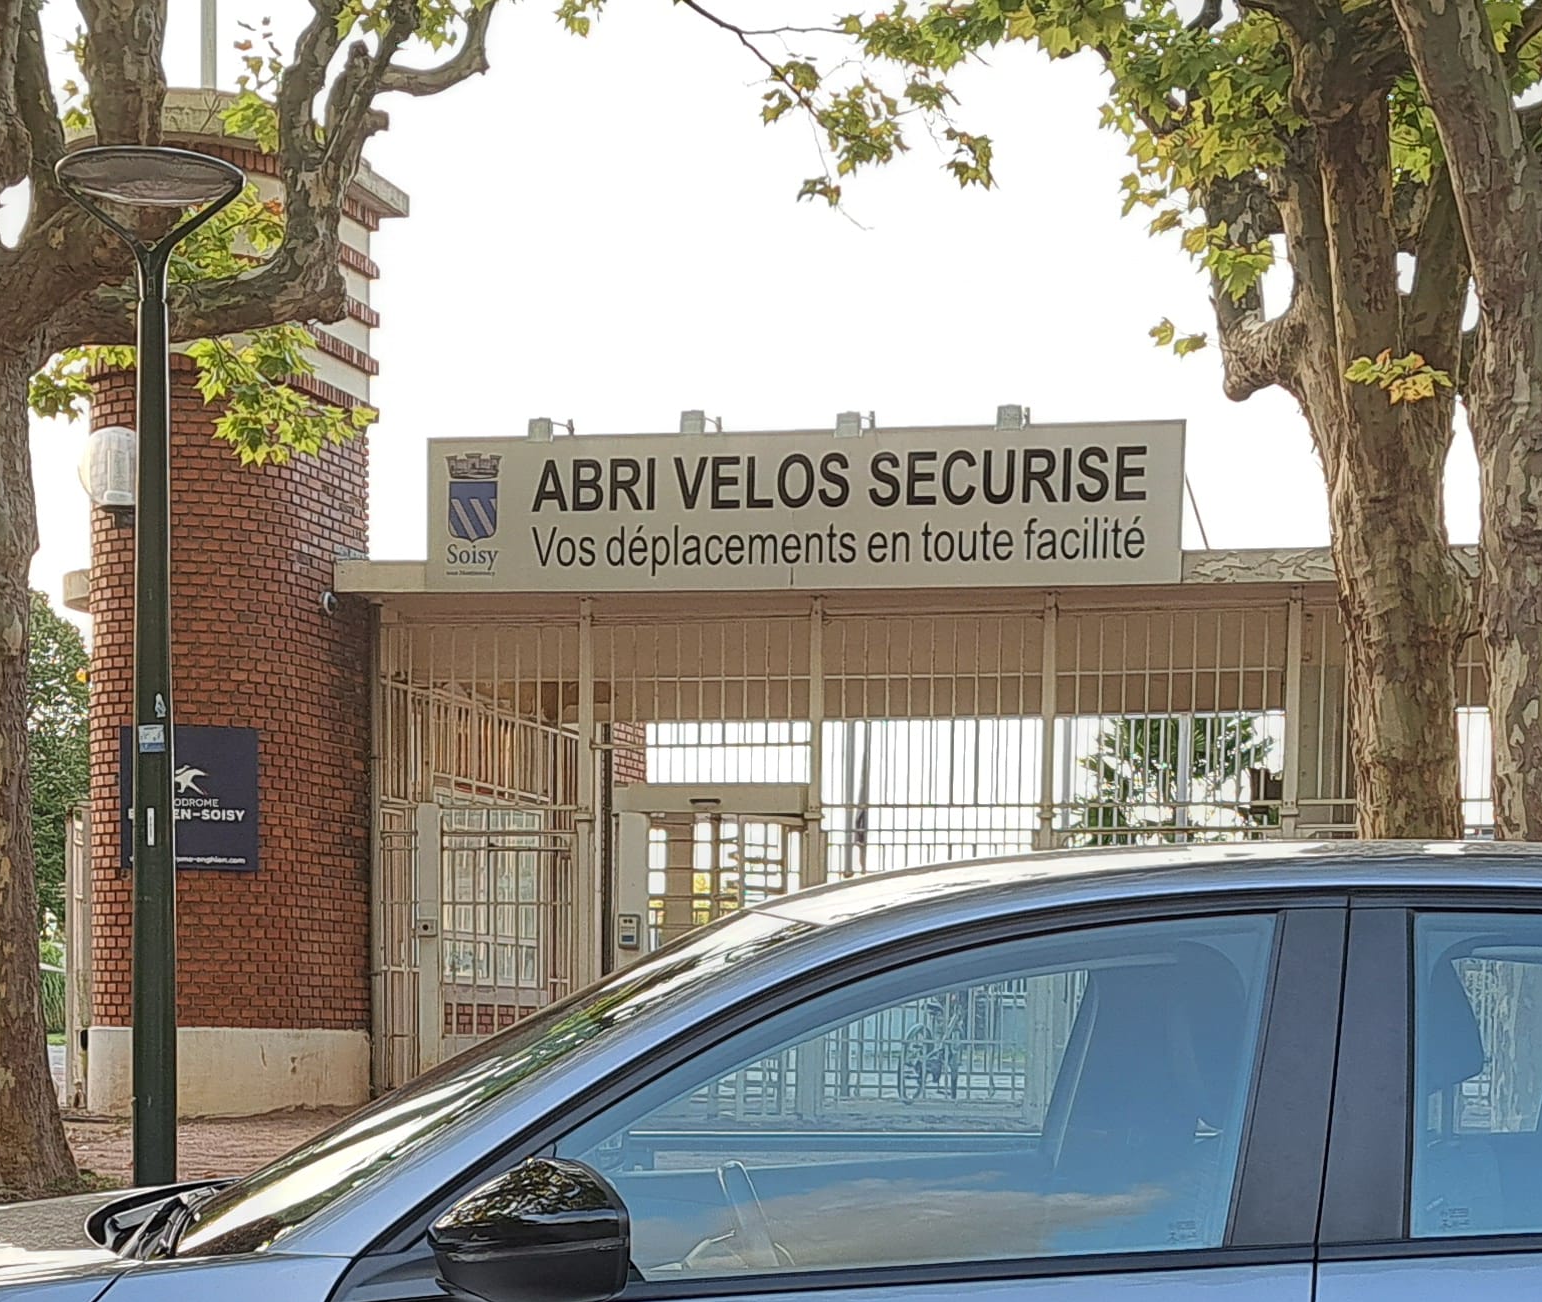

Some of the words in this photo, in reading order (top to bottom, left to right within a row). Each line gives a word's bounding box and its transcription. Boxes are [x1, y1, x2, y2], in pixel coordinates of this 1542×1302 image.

[531, 457, 656, 512] ABRI
[673, 451, 850, 510] VELOS
[867, 445, 1148, 507] SECURISE
[445, 543, 499, 571] Soisy
[531, 525, 596, 567] Vos
[607, 522, 857, 577] déplacements
[867, 529, 910, 564] en
[921, 520, 1014, 562] toute
[1023, 515, 1146, 561] facilité
